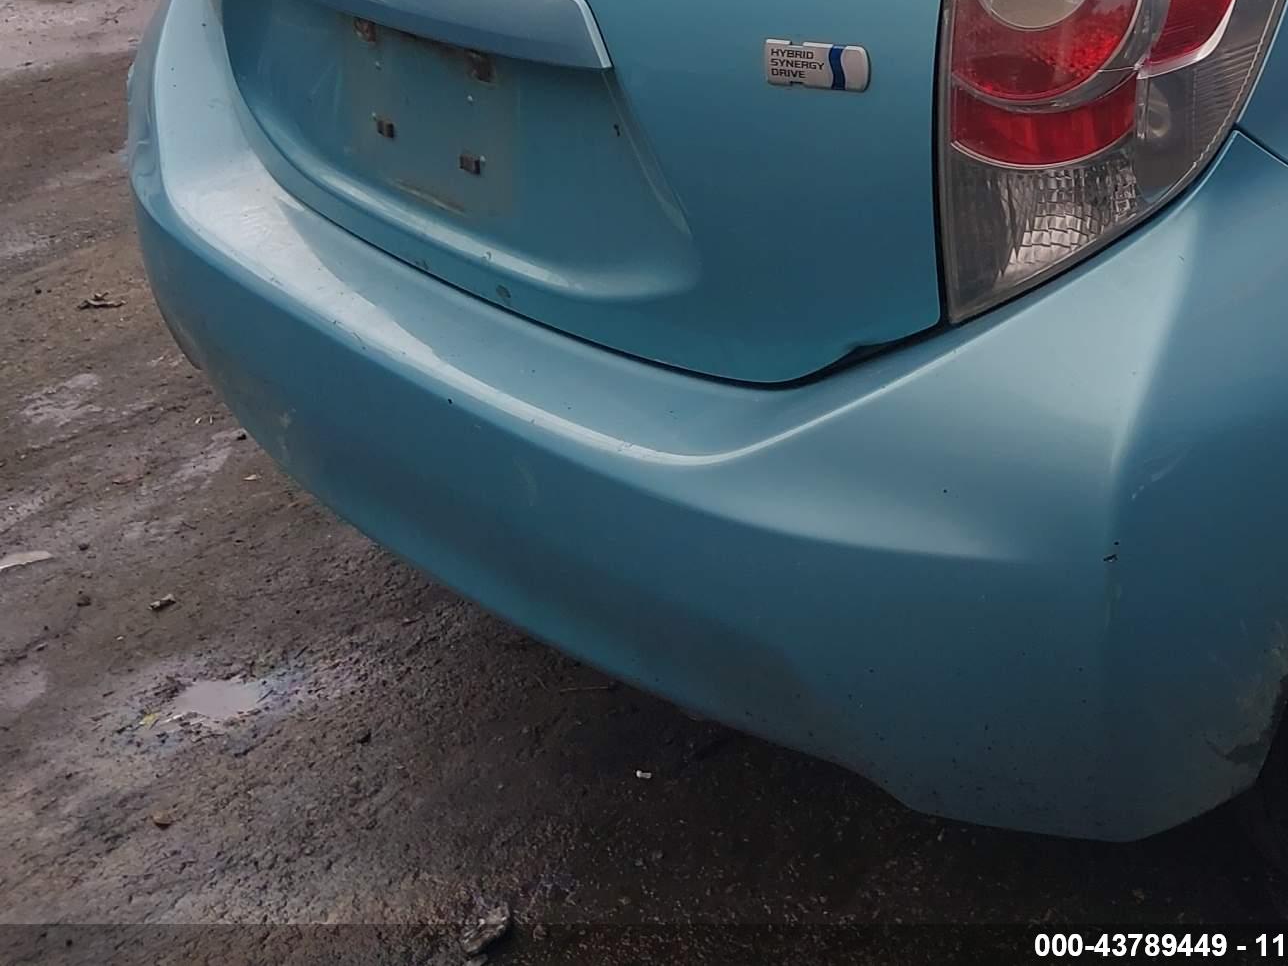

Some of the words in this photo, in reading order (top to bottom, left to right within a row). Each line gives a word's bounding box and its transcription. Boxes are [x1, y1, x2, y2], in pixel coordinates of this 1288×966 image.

[770, 48, 814, 60] HYBRID
[770, 58, 825, 70] SYNERGY
[771, 68, 806, 79] DRIVE
